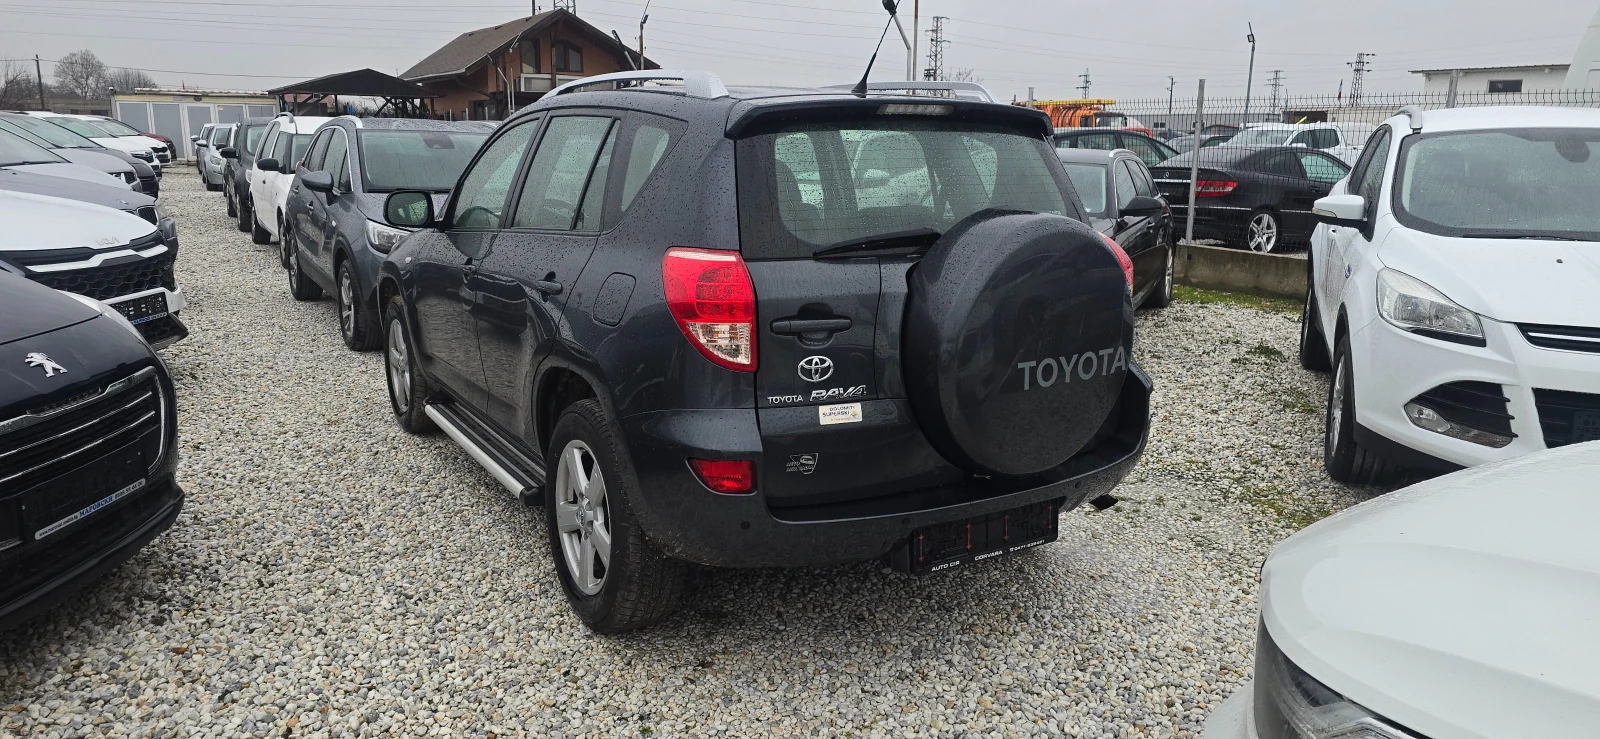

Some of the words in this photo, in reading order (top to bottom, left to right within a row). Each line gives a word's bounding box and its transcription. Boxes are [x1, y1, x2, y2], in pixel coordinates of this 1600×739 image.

[1018, 346, 1126, 391] TOYOTA
[767, 395, 803, 404] TOYOTA
[810, 385, 867, 401] RAV4
[931, 562, 949, 572] AUTO
[974, 550, 1003, 561] CORVARA
